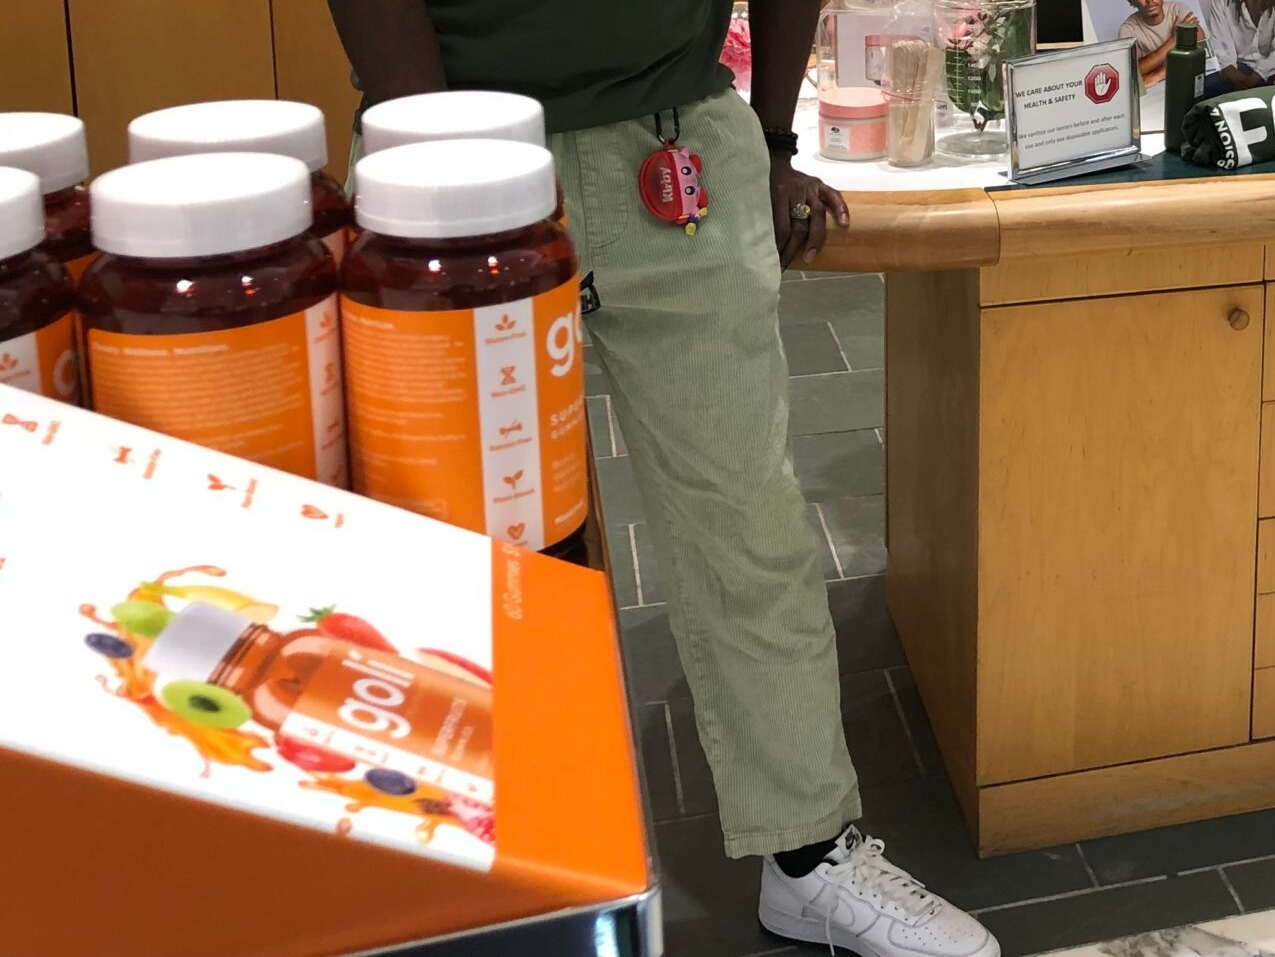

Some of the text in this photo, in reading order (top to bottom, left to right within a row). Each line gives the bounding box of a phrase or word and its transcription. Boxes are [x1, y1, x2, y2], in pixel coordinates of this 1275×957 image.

[1027, 87, 1042, 96] CARE
[1043, 83, 1064, 93] ABOUT
[1066, 80, 1083, 88] YOUR
[1024, 99, 1047, 109] HEALTH
[1054, 94, 1075, 103] SAFETY
[1066, 131, 1090, 140] disposable
[660, 166, 674, 203] Kirby
[337, 648, 416, 740] goli
